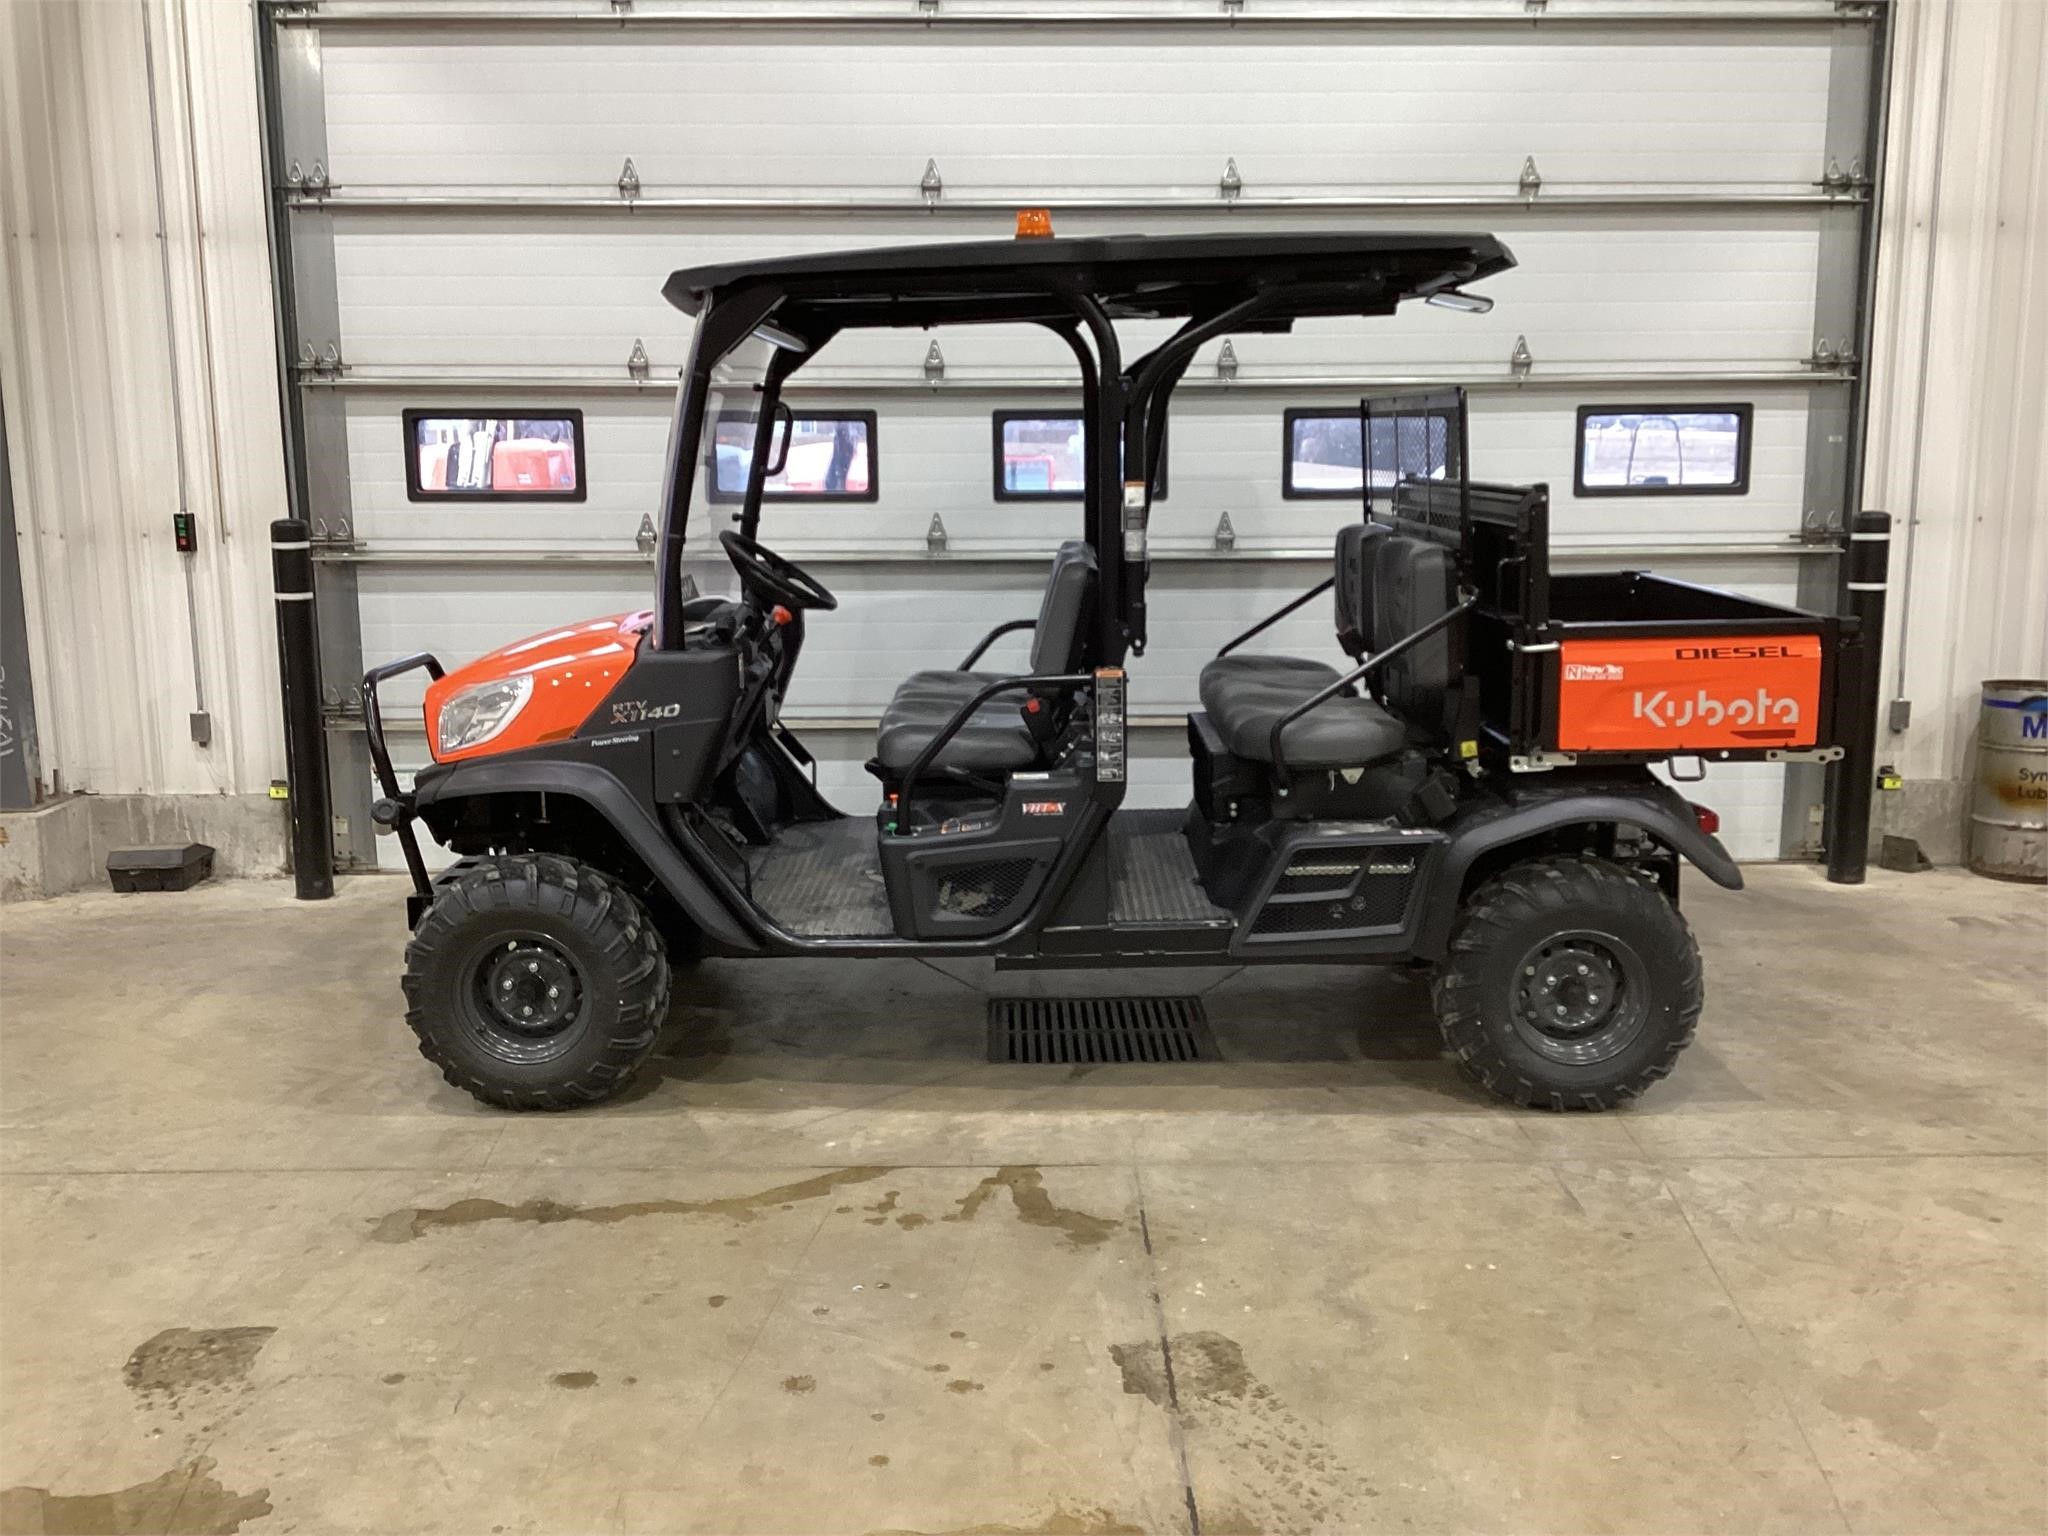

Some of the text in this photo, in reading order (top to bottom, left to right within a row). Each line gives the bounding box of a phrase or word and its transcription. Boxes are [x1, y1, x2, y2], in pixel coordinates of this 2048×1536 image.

[1676, 646, 1803, 660] DIESEL
[1633, 688, 1799, 728] Kubota
[591, 734, 639, 747] Power Steering
